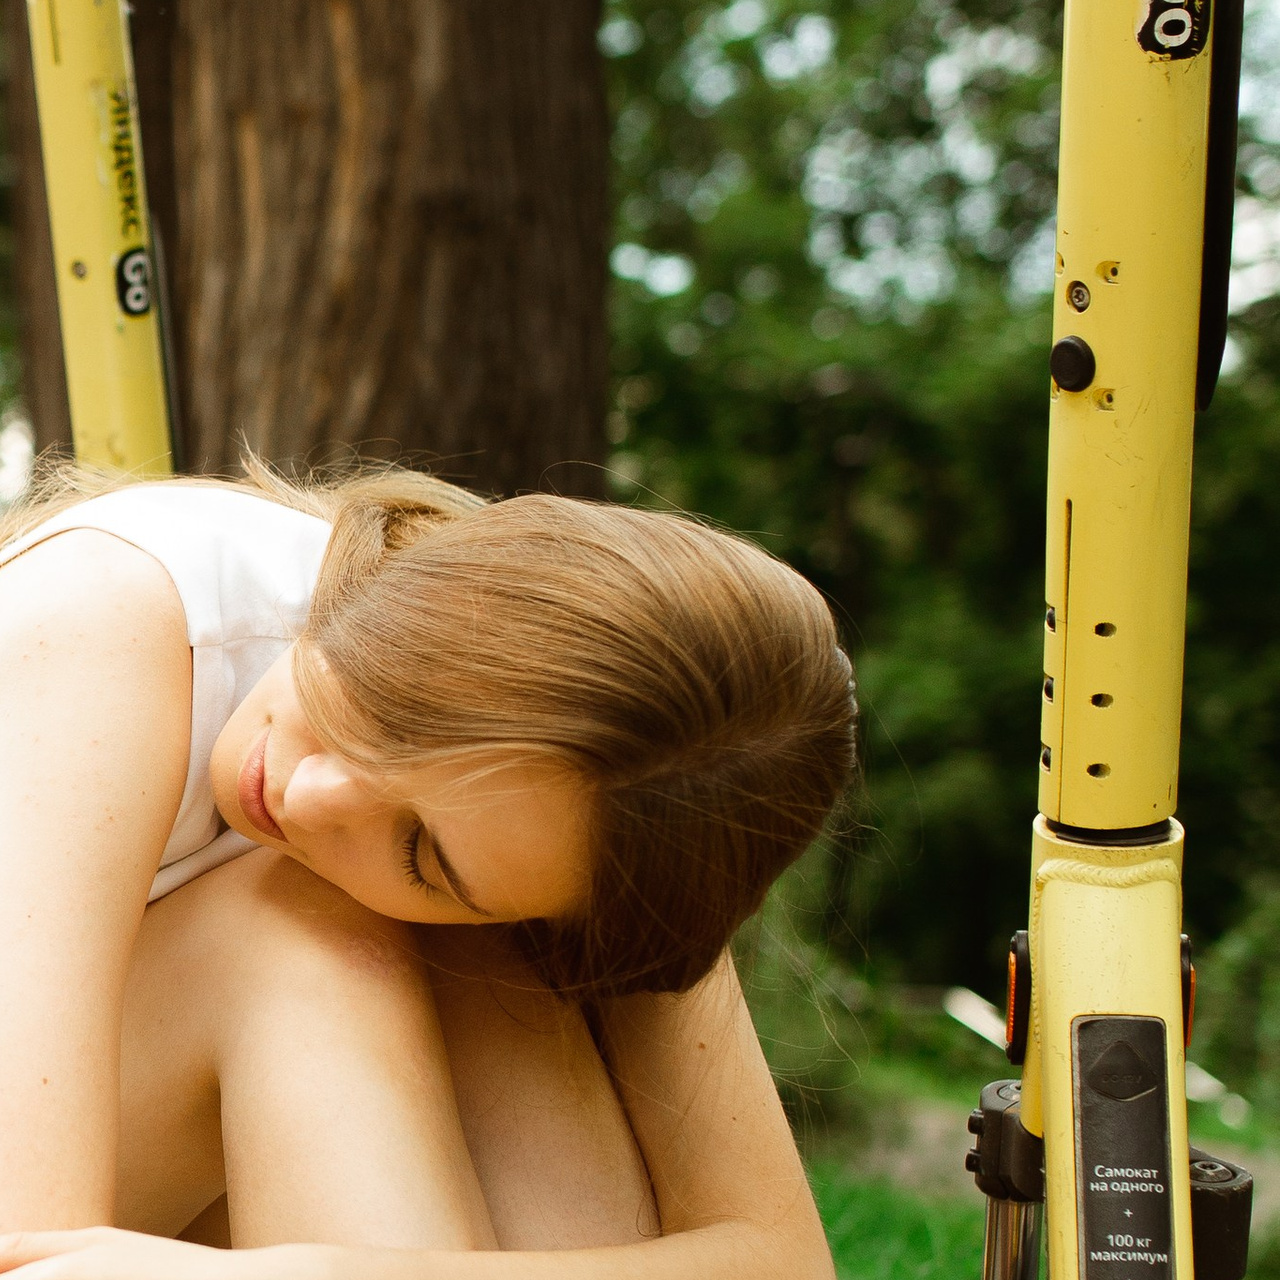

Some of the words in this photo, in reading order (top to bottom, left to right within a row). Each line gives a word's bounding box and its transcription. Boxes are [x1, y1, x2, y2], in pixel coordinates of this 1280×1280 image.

[123, 252, 152, 312] Go
[1094, 1165, 1159, 1179] Самокат
[1090, 1181, 1108, 1192] на
[1110, 1181, 1164, 1194] одного
[1107, 1234, 1134, 1247] 100
[1136, 1237, 1152, 1248] кг
[1090, 1251, 1168, 1265] максимум
